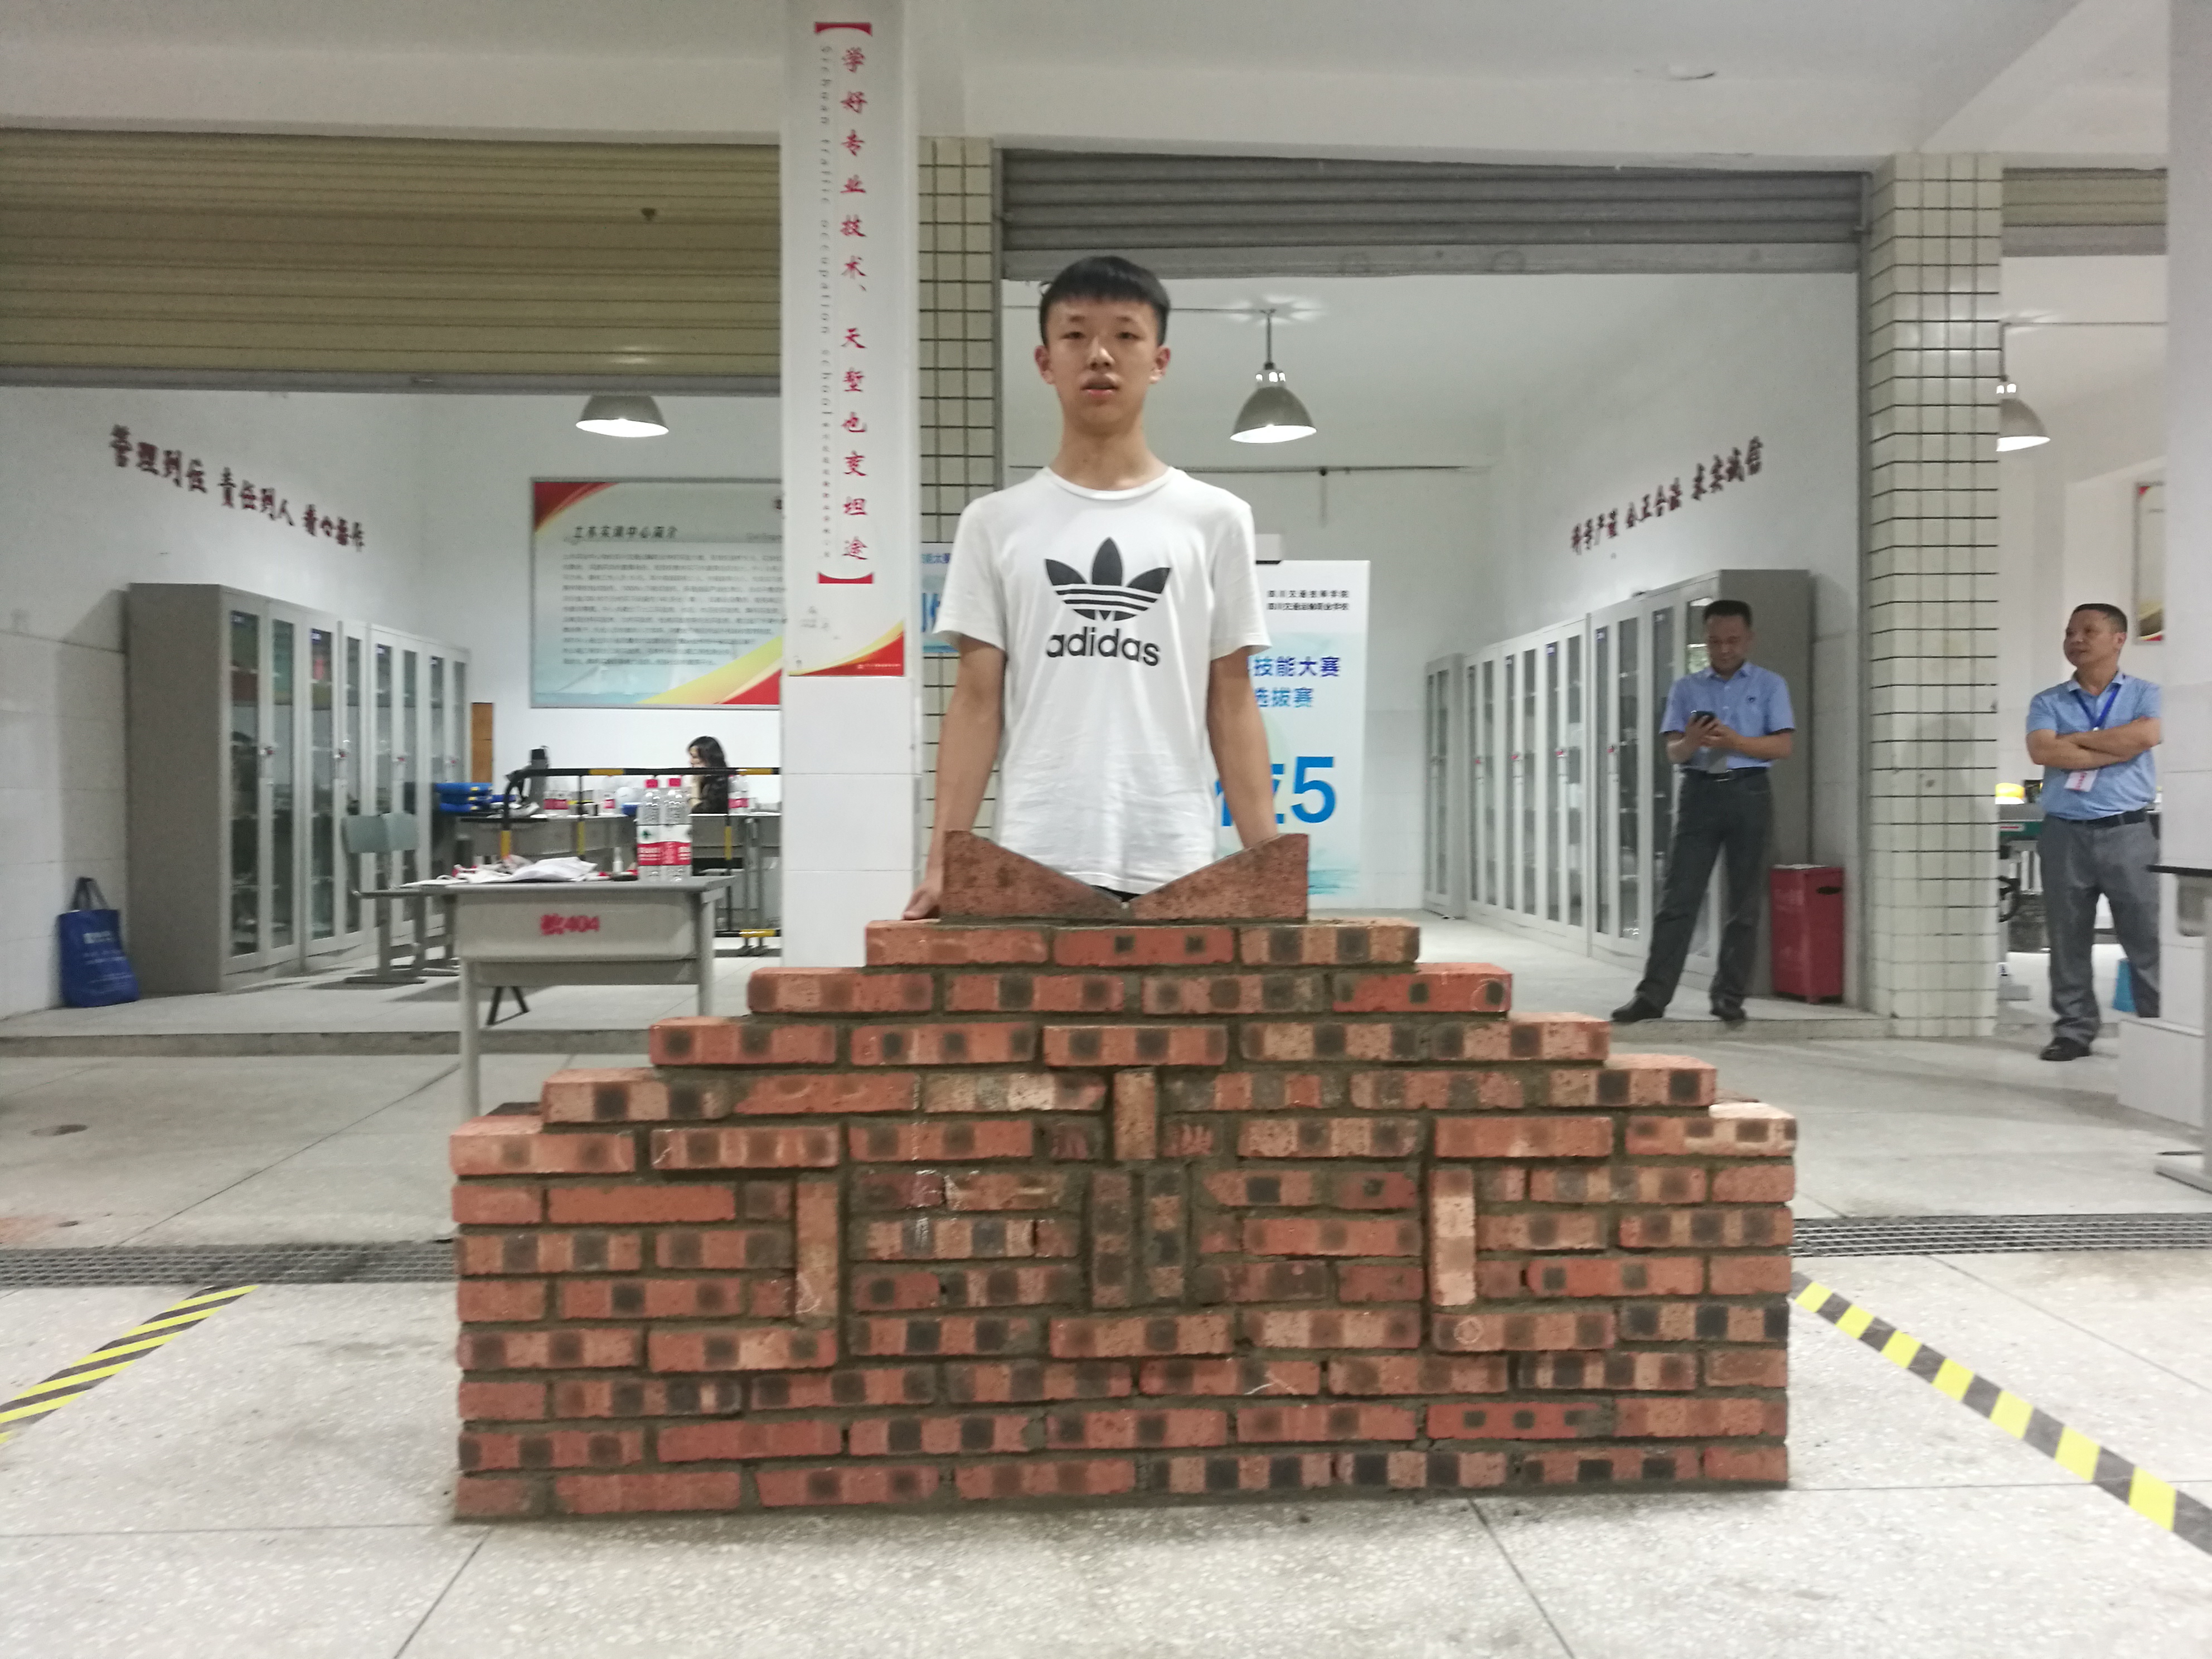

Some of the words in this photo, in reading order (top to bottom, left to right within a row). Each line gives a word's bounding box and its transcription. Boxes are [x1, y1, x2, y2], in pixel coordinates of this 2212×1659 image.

[1046, 627, 1160, 666] adidas
[1249, 656, 1341, 677] 技能大赛
